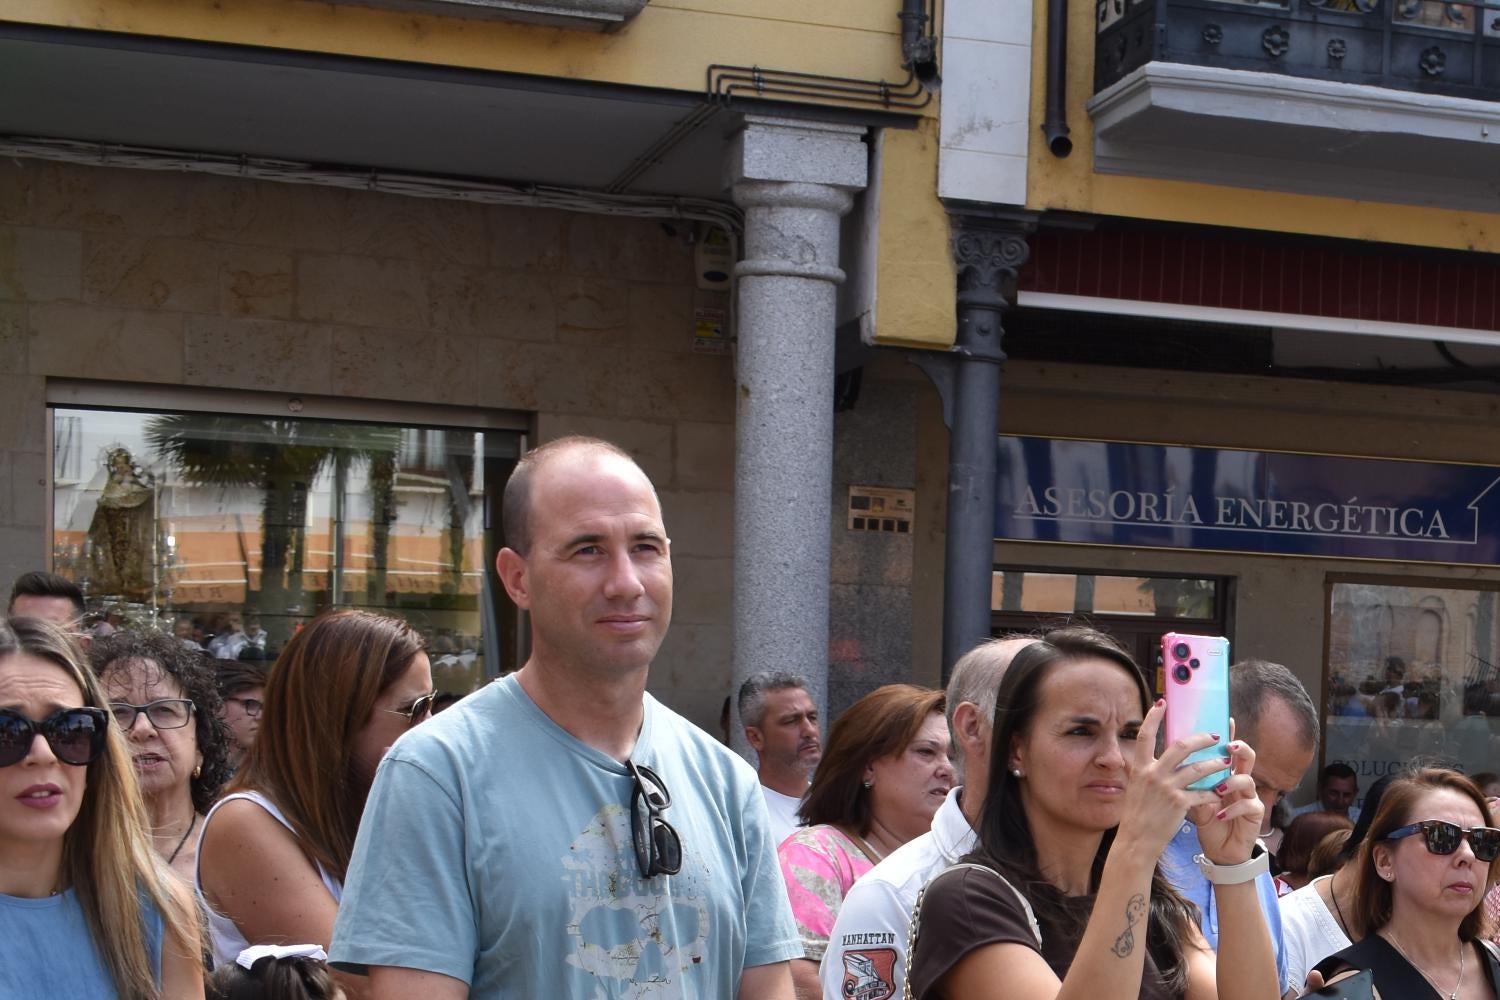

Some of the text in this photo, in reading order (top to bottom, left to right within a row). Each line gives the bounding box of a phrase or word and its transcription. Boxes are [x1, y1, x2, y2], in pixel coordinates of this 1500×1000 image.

[1014, 485, 1451, 539] ASESORÍA ENERGÉTICA
[842, 933, 896, 946] MANHATTAN
